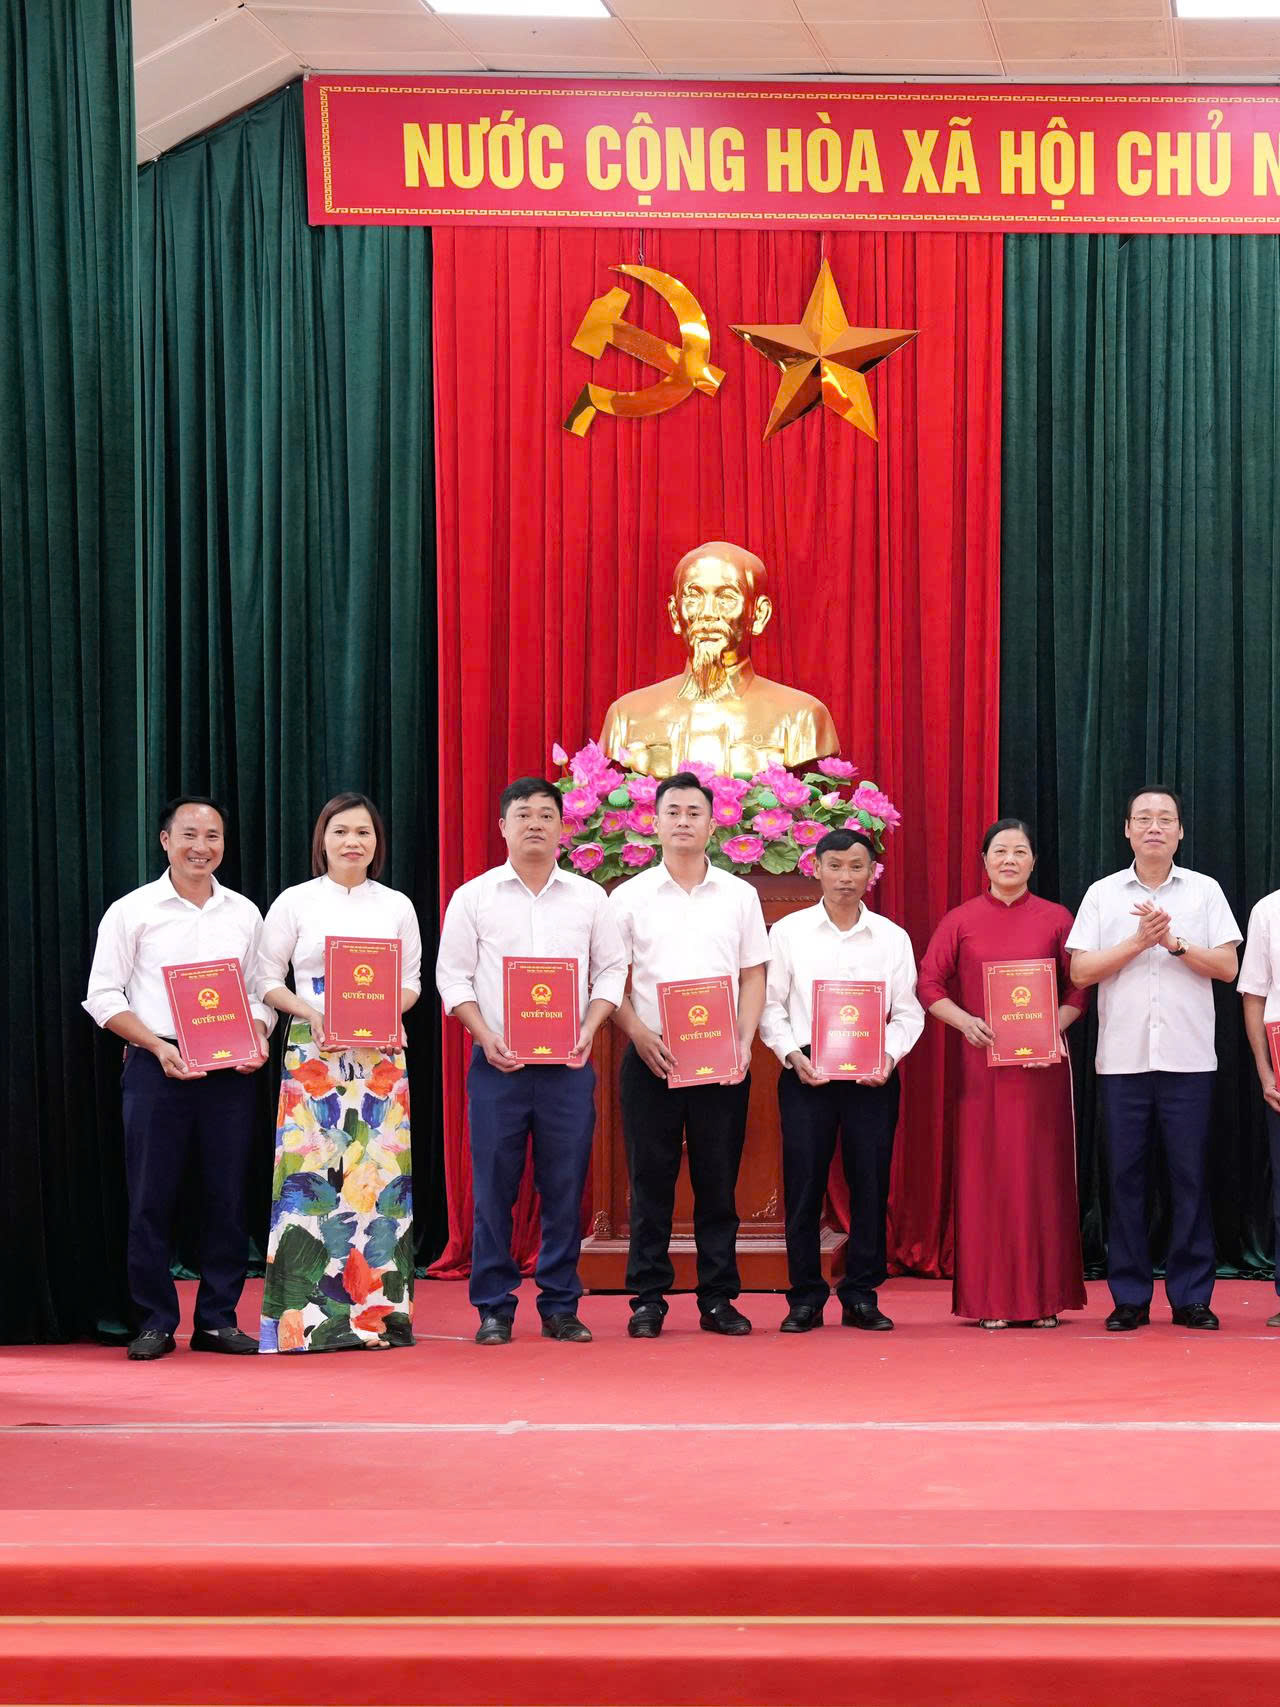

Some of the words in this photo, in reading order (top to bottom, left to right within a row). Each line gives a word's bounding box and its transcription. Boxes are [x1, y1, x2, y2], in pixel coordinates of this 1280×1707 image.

[404, 110, 564, 190] NƯỚC
[586, 112, 745, 205] CỘNG
[767, 112, 883, 193] HÒA
[903, 117, 980, 194] XÃ
[1001, 117, 1094, 210] HỘI
[1117, 108, 1231, 197] CHỦ
